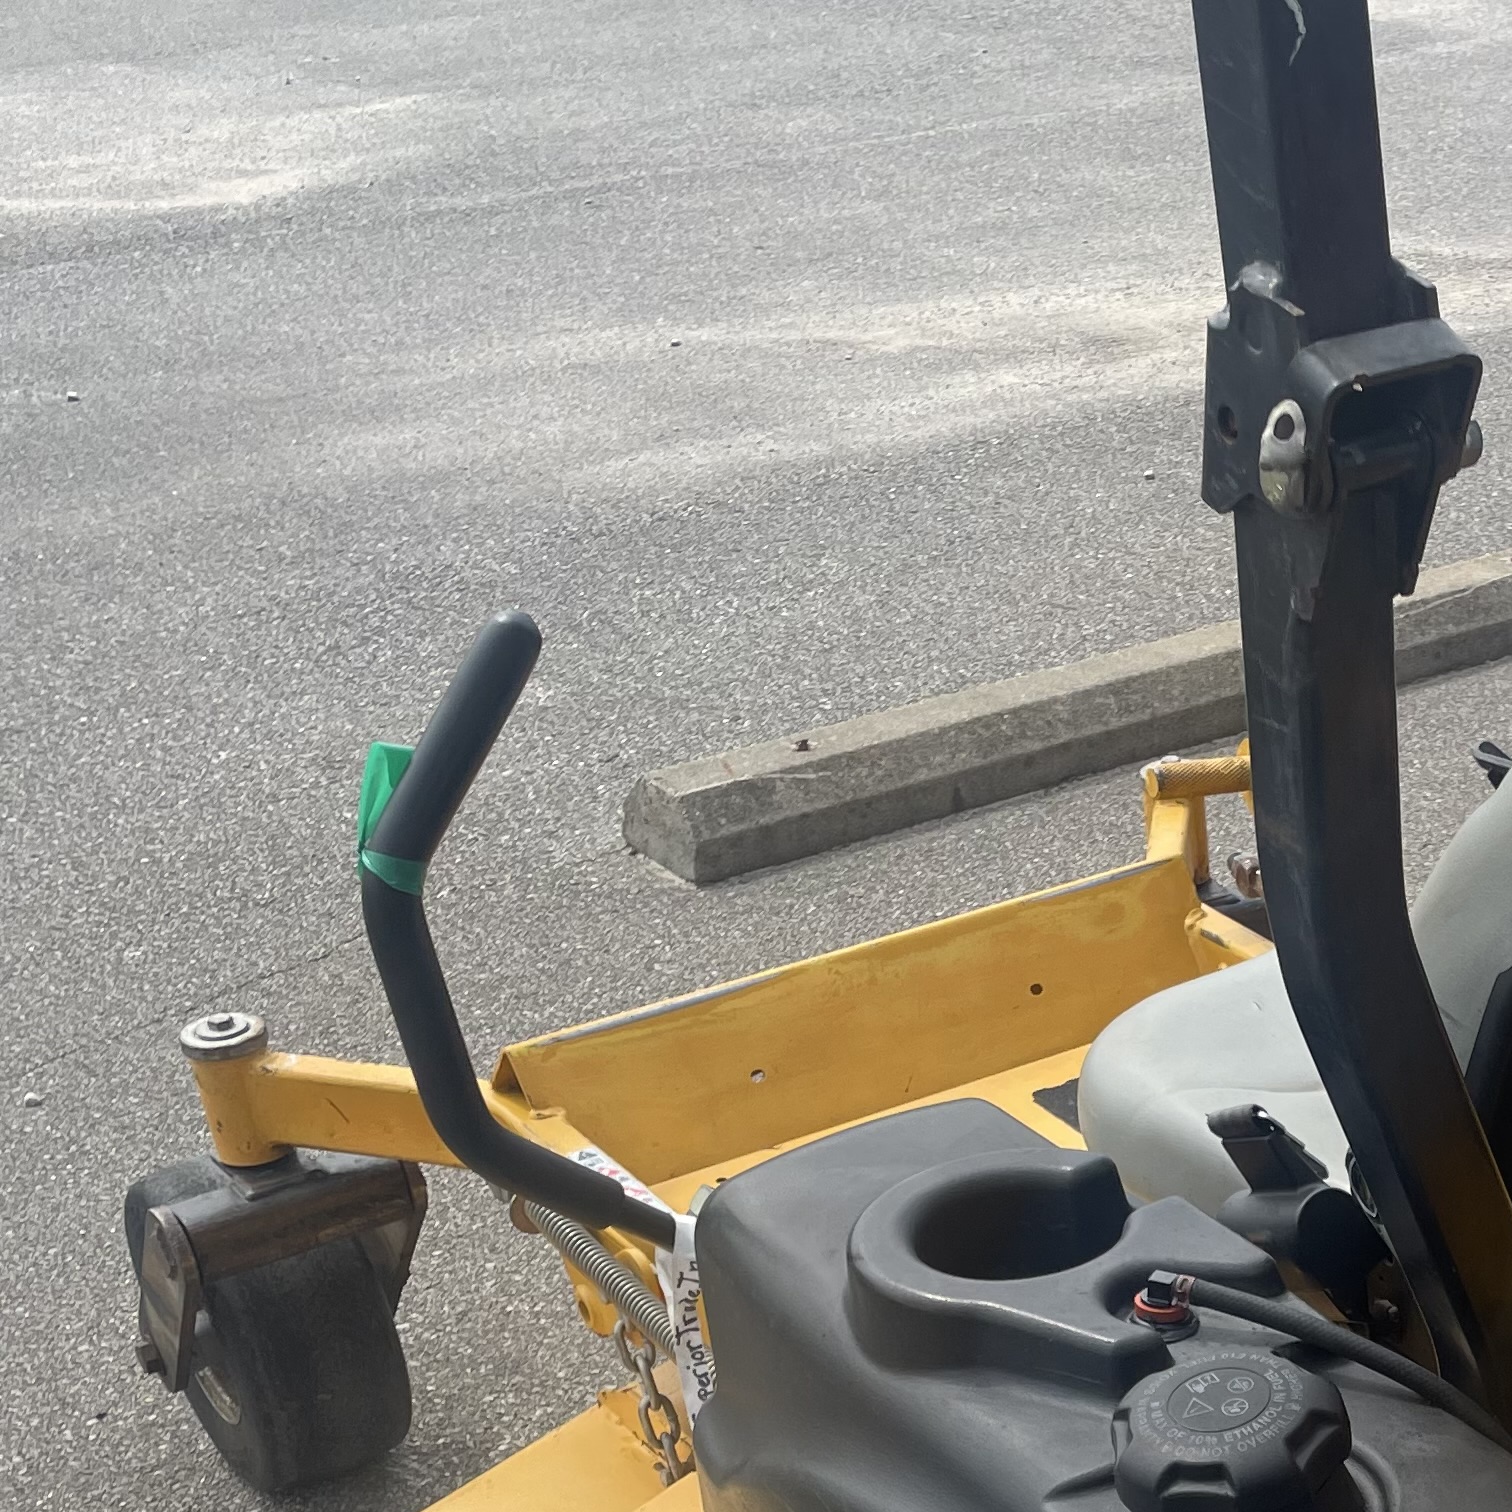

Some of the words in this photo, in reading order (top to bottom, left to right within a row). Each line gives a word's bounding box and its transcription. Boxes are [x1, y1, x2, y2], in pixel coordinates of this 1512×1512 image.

[1263, 1369, 1286, 1391] FUEL
[1273, 1391, 1287, 1403] IN
[1166, 1428, 1187, 1441] OF
[1223, 1404, 1283, 1443] ETHANOL
[1201, 1445, 1231, 1457] NOT
[1236, 1413, 1295, 1452] OVERFILL
